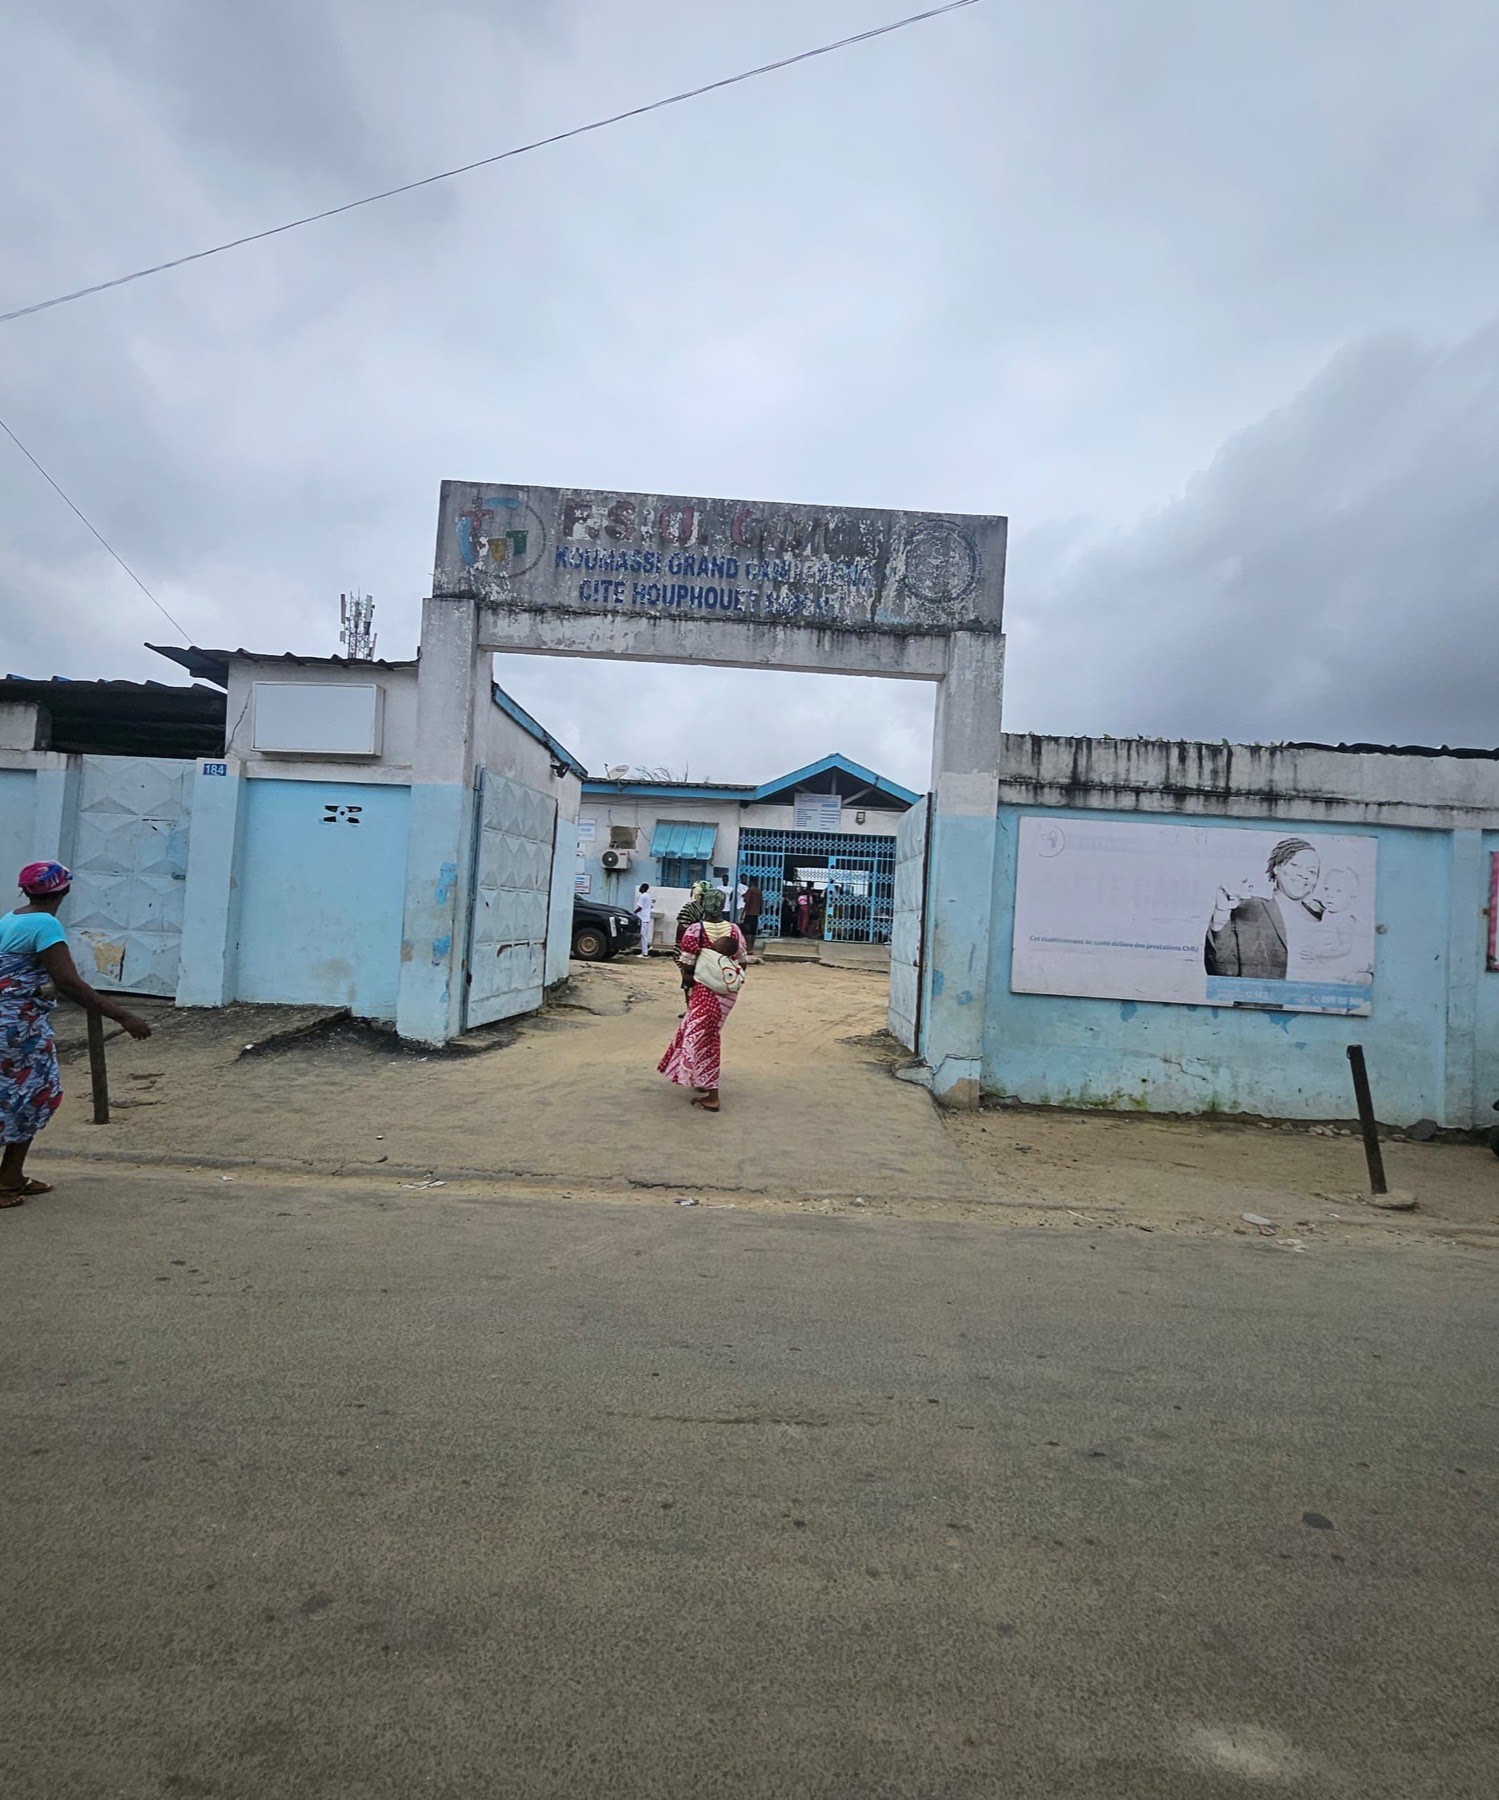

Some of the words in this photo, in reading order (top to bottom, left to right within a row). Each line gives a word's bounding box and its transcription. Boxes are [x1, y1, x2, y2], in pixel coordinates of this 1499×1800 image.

[555, 545, 661, 574] KOUMASSI
[668, 552, 739, 580] GRAND
[579, 578, 626, 604] CITE
[205, 764, 225, 775] 184
